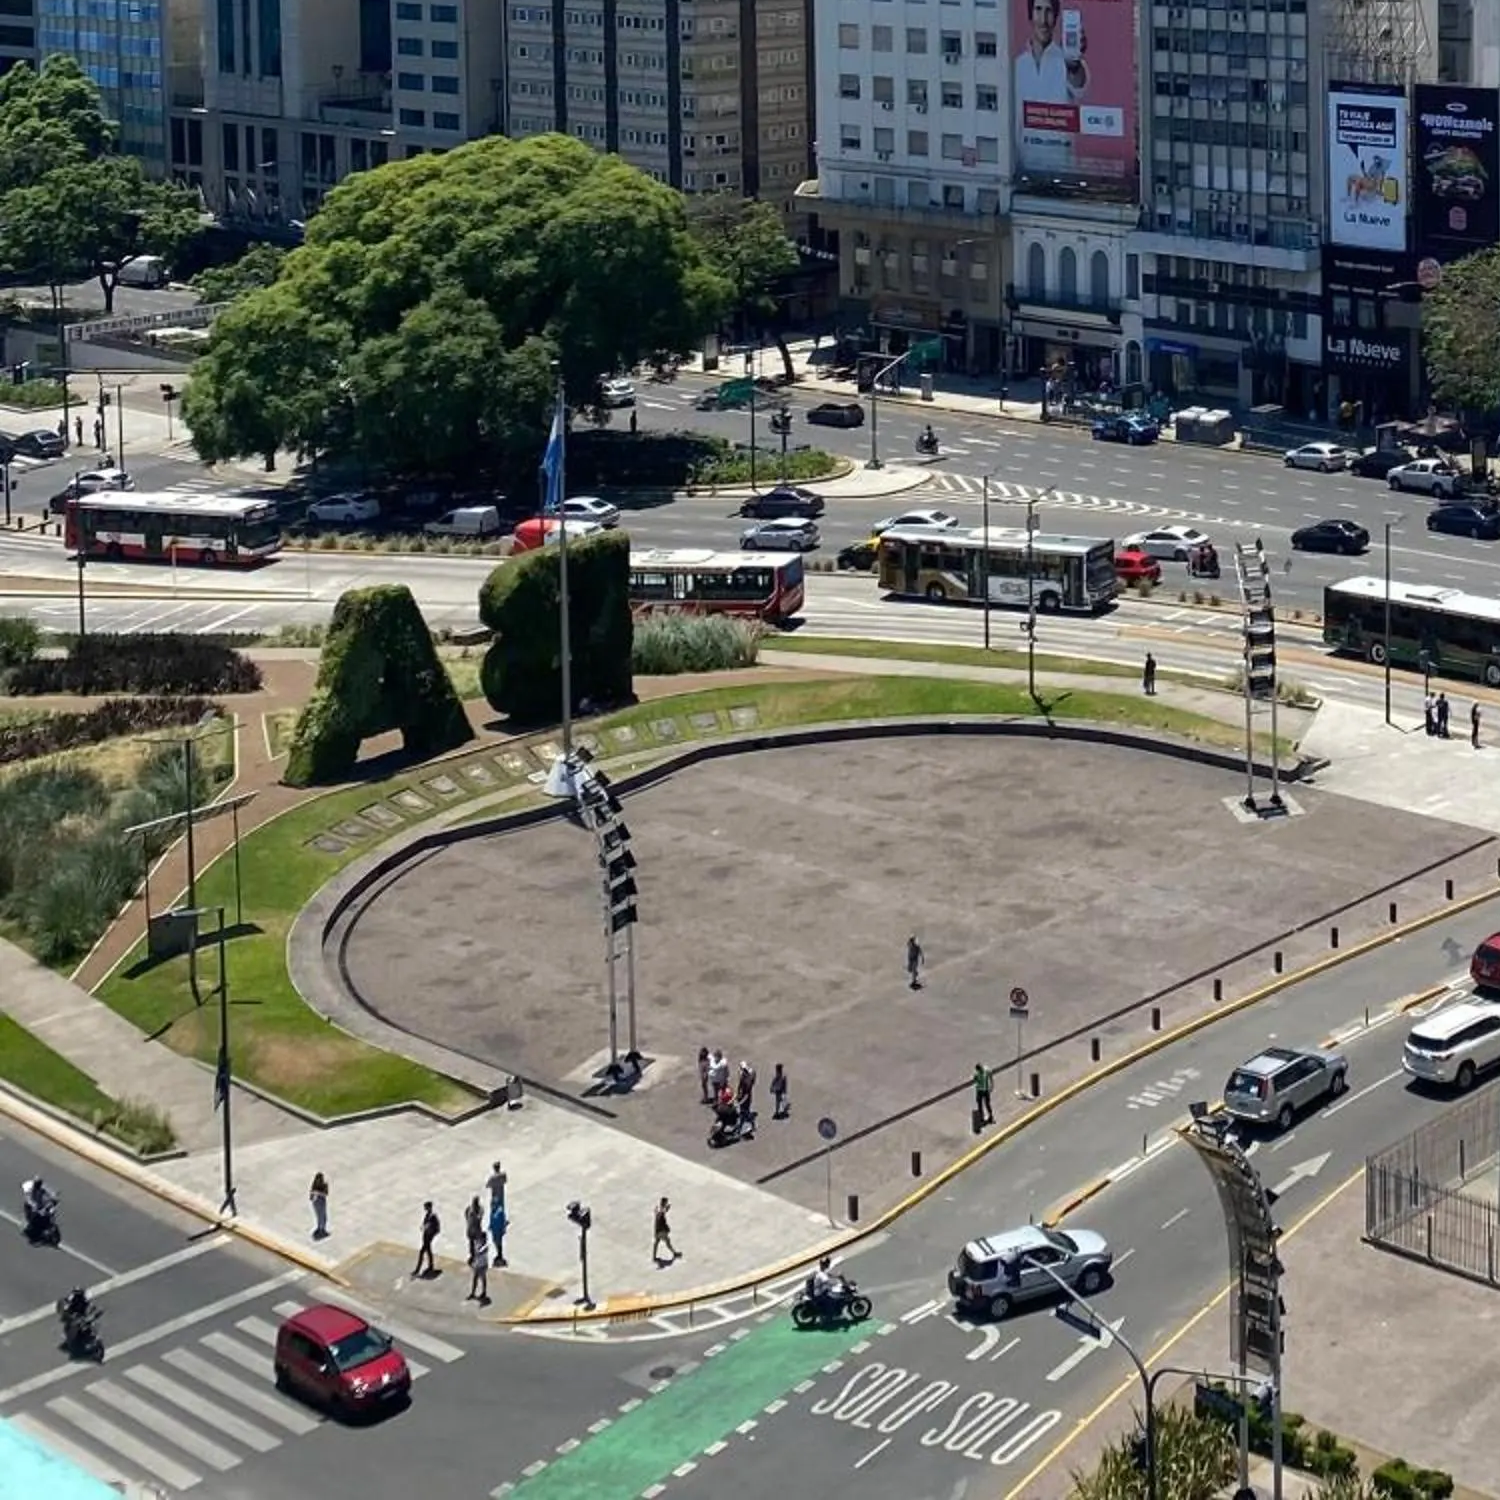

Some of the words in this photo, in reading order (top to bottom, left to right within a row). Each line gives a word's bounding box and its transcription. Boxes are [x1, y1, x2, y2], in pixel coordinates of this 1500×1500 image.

[1344, 212, 1357, 224] La
[1359, 213, 1391, 227] Nueve
[1327, 335, 1346, 354] La
[1349, 338, 1401, 361] Nueve
[811, 1362, 951, 1434] SOLO
[920, 1391, 1063, 1465] SOLO
